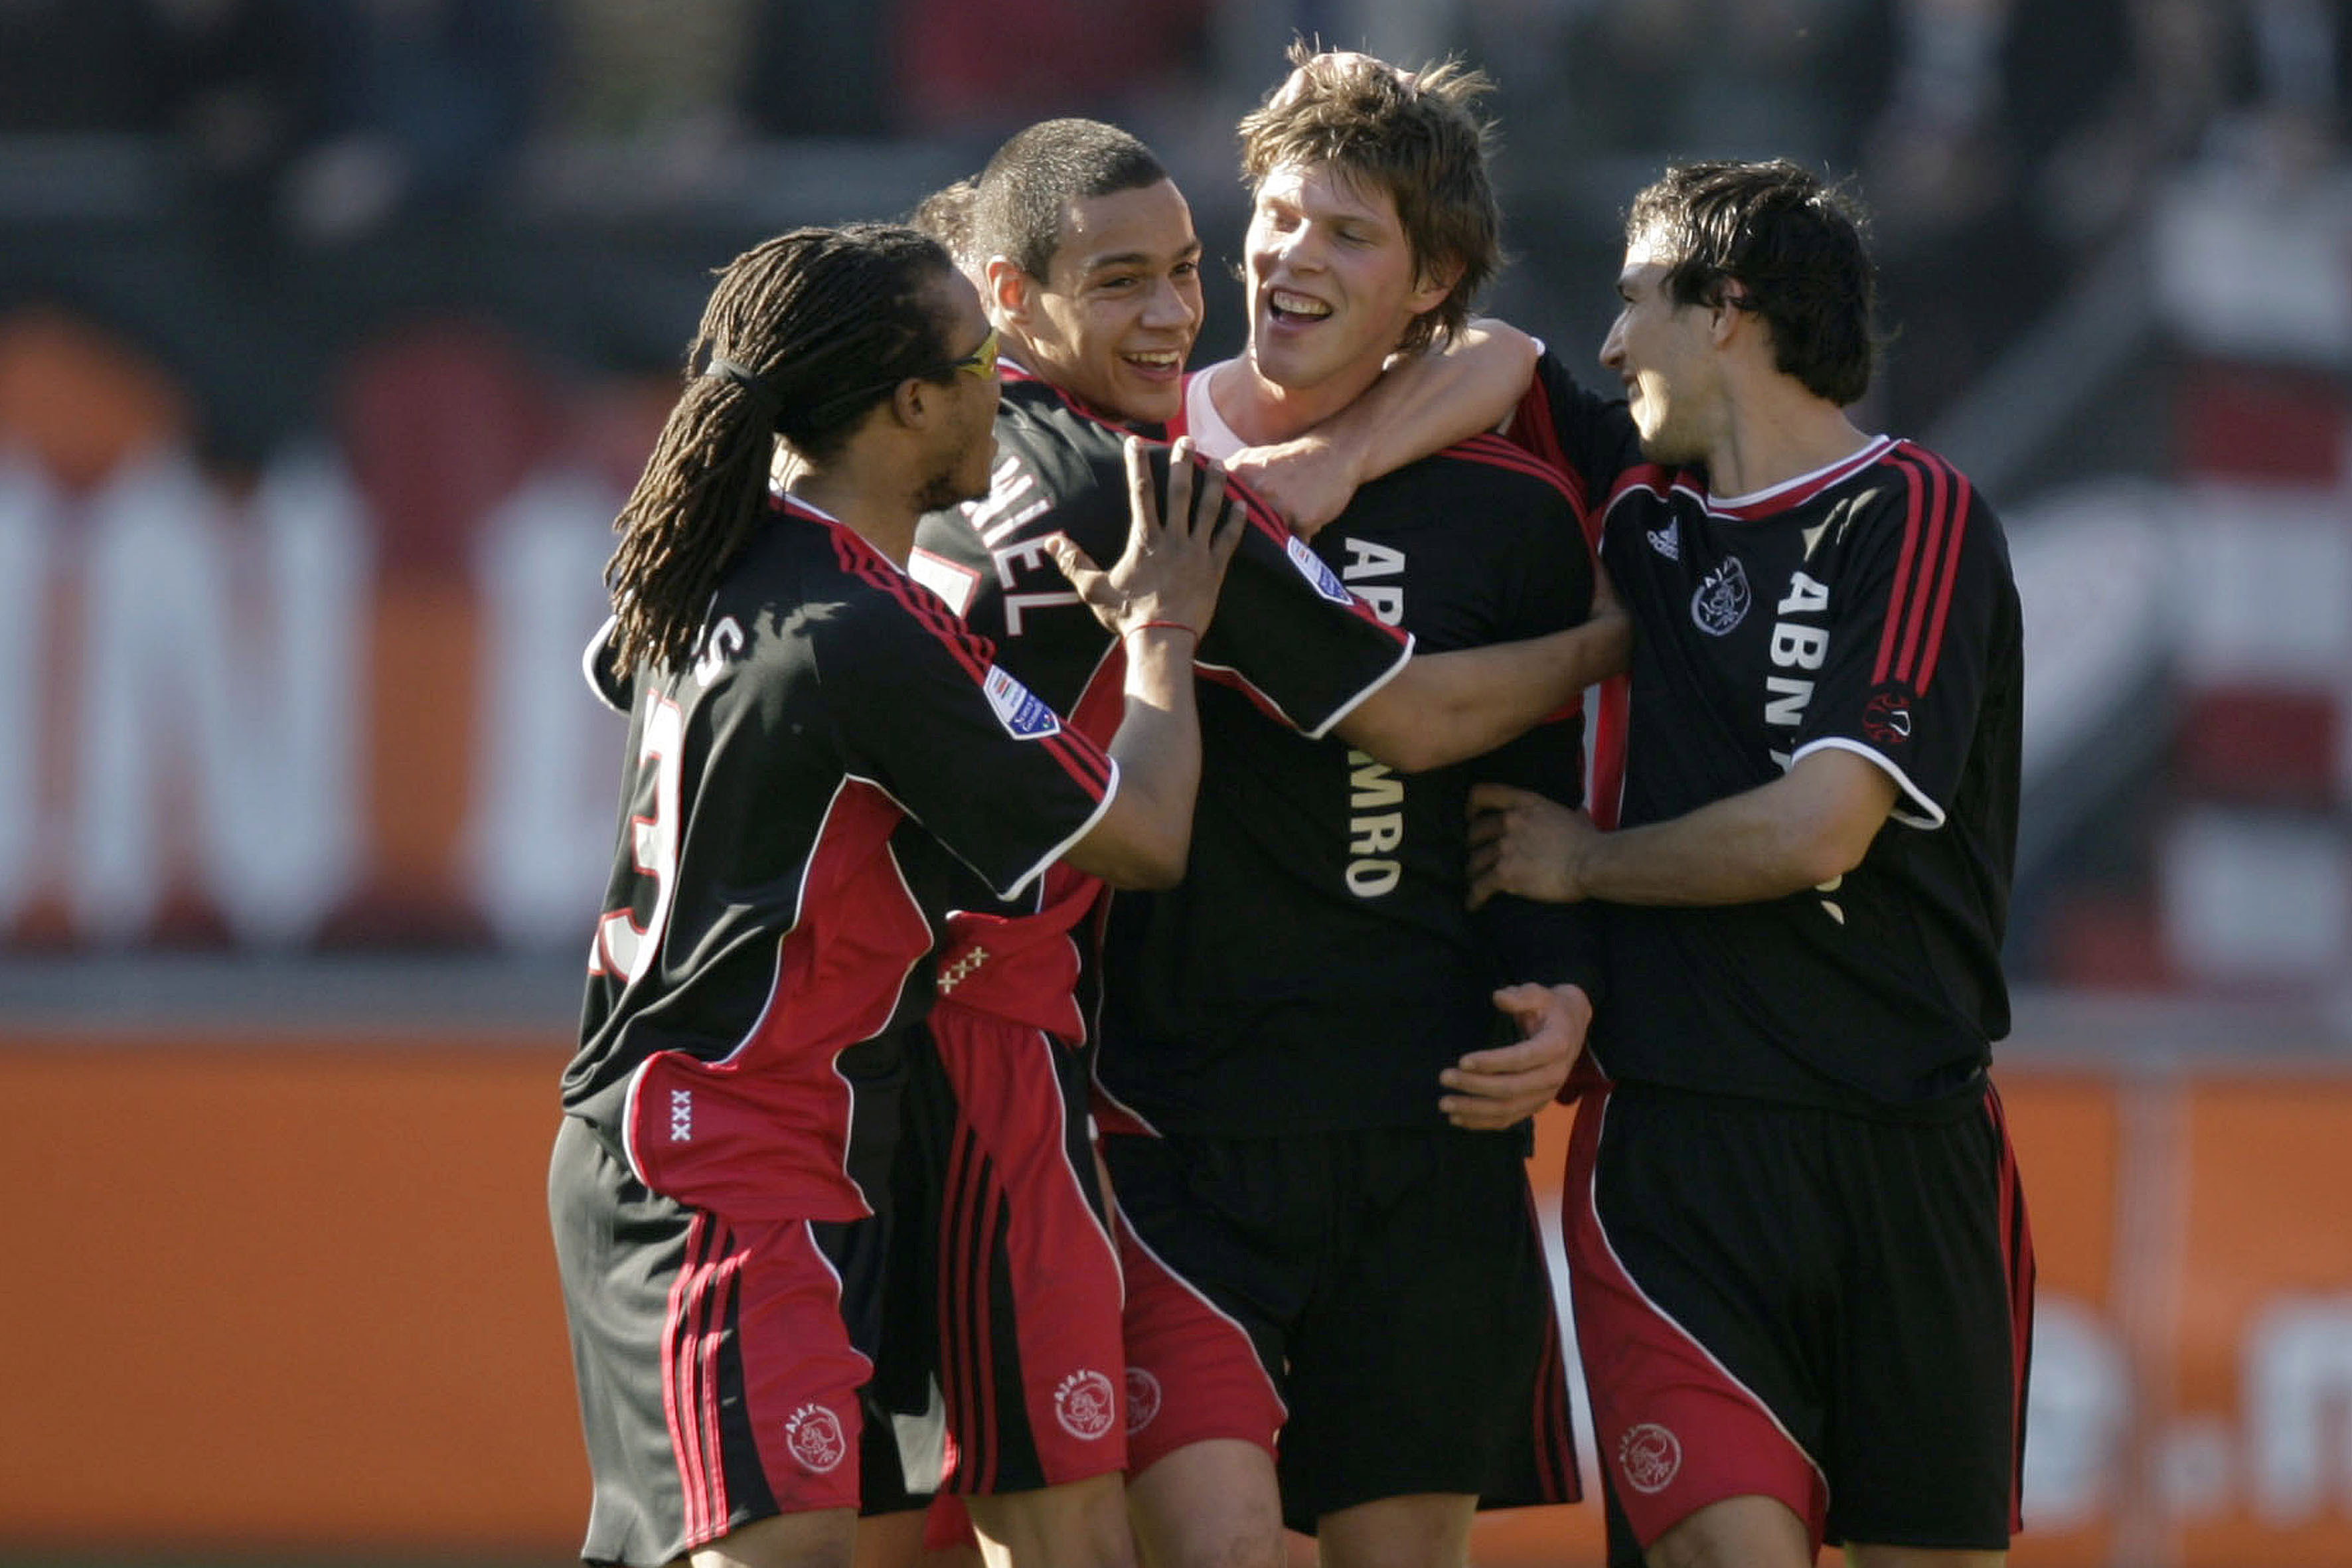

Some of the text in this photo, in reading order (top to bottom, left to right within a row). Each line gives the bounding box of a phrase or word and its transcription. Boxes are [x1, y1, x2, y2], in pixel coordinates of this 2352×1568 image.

[1765, 571, 1830, 726] ABN
[588, 688, 684, 985] 3
[1346, 750, 1405, 898] MRO
[785, 1402, 815, 1434] AJAX
